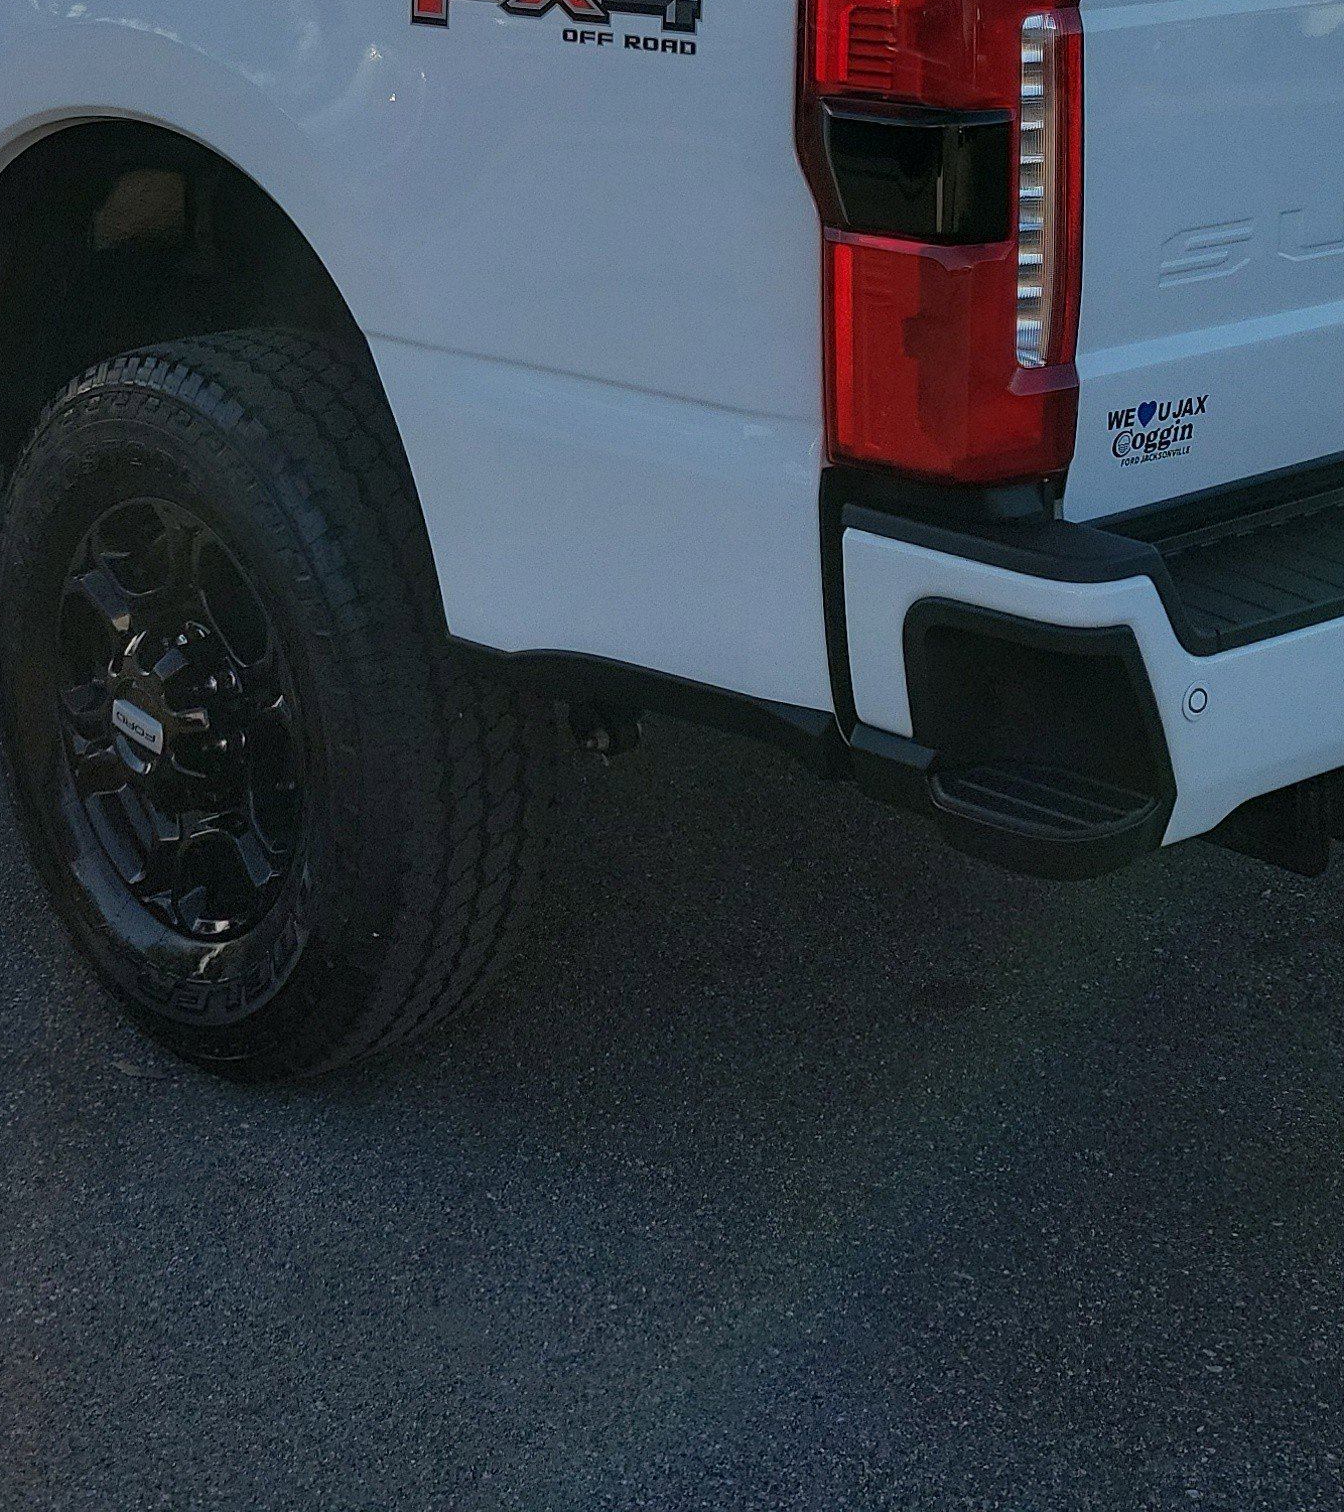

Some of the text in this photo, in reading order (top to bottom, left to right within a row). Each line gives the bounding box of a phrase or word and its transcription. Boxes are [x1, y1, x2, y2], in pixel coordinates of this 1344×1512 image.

[562, 29, 697, 55] OFF ROAD
[1107, 394, 1209, 430] WE U JAX
[1112, 419, 1193, 458] Coggin
[1120, 445, 1191, 467] FORD JACKSONVILLE
[116, 711, 156, 743] FORD
